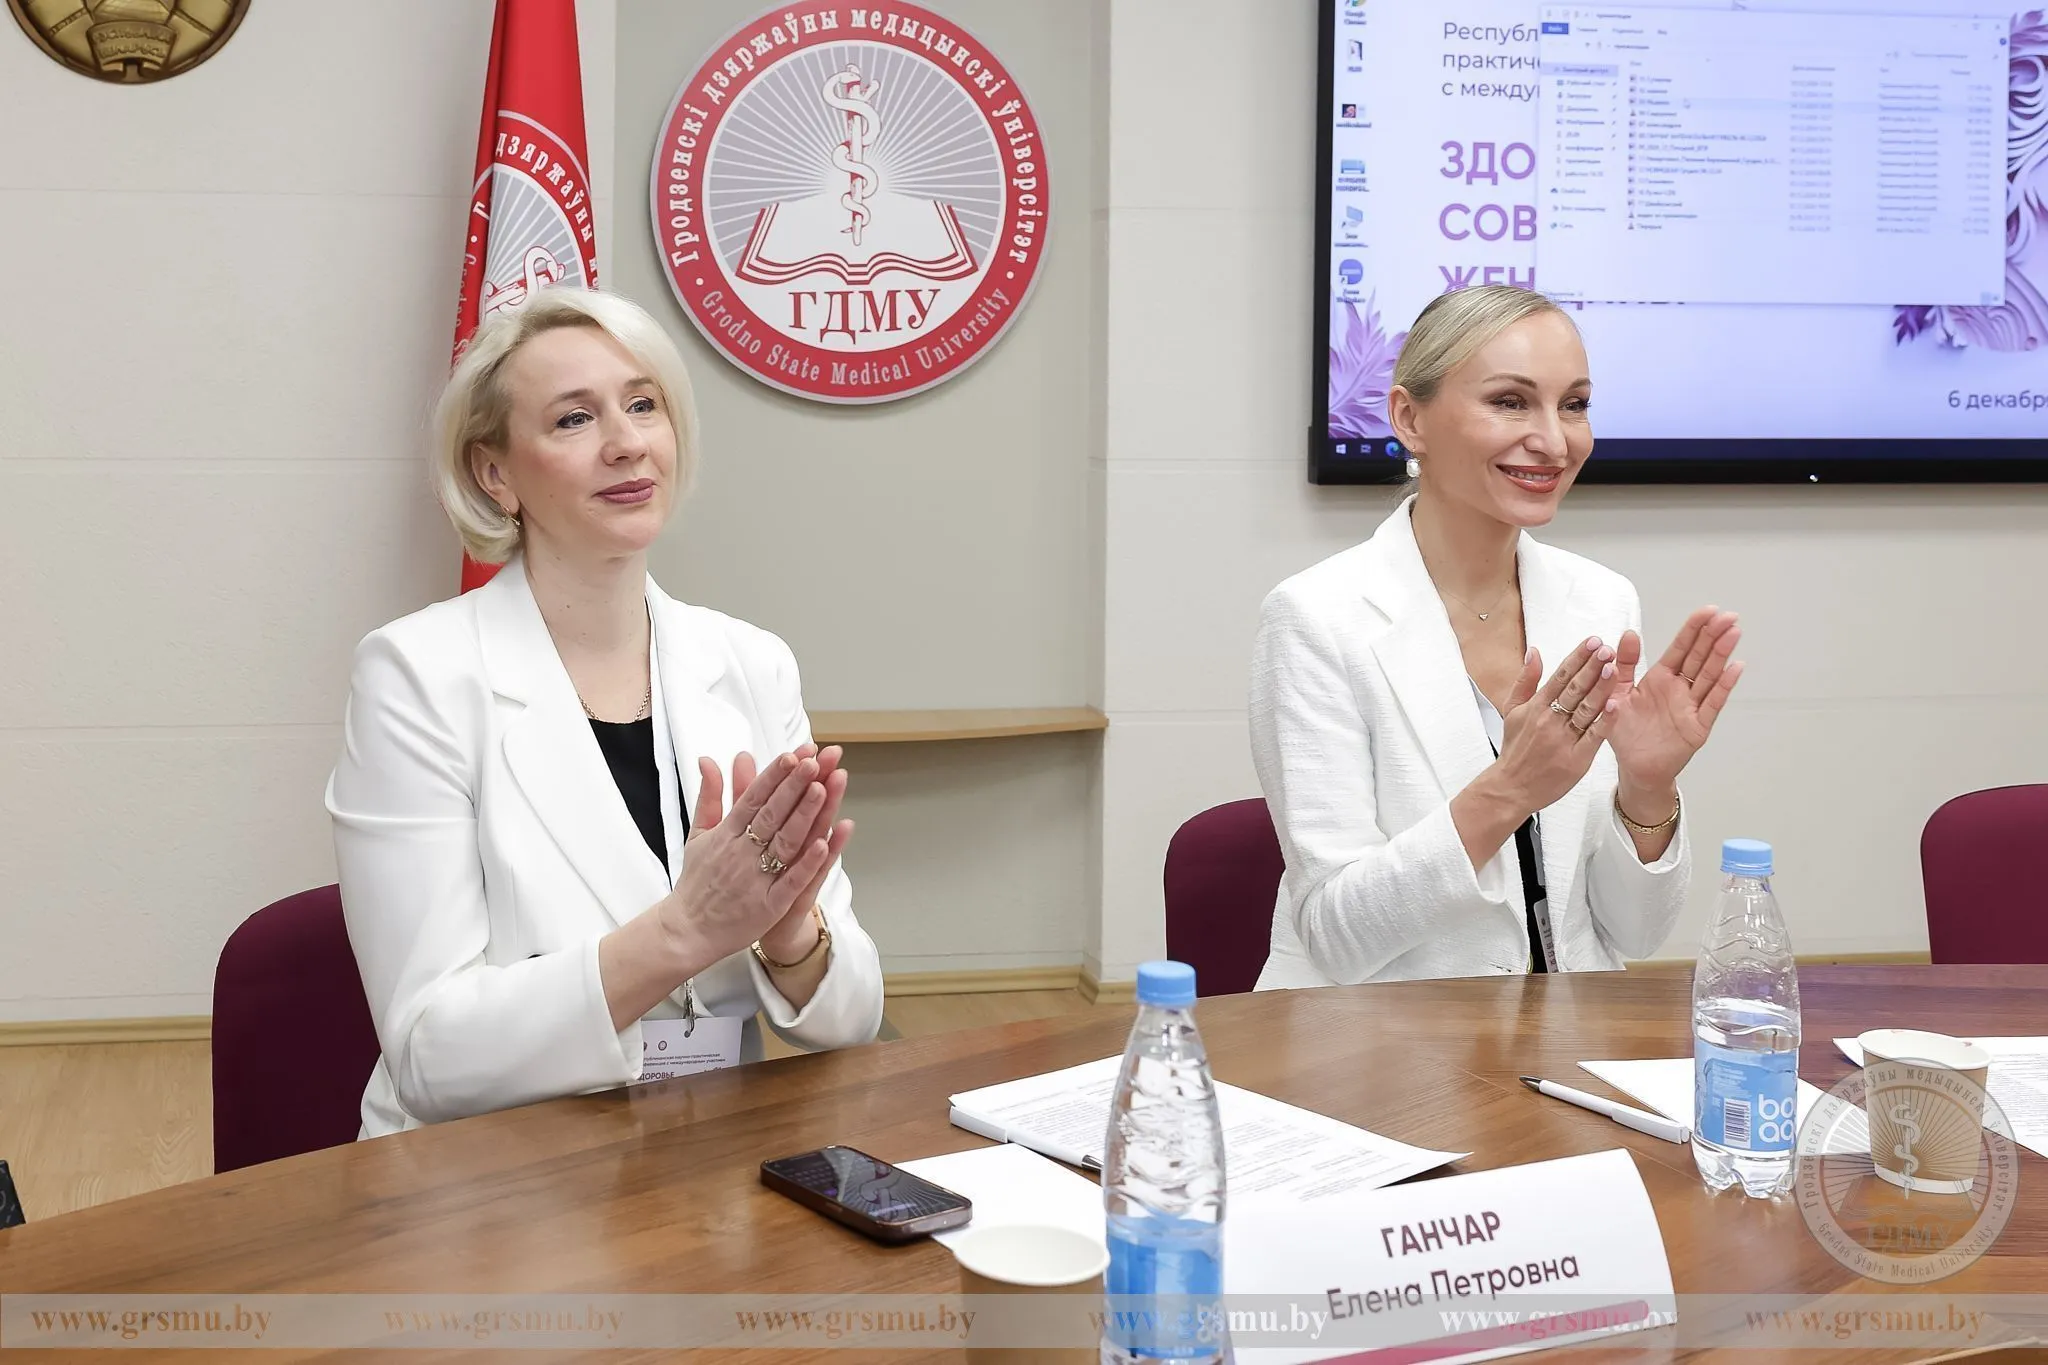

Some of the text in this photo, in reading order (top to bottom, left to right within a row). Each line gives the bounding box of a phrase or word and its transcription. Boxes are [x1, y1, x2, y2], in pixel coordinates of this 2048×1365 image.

[1442, 83, 1453, 96] с
[669, 8, 1043, 268] Гродзенскі дзяржаўны медыцынскі ўніверсітэт
[1440, 140, 1536, 186] ЗДО
[495, 132, 592, 243] дзяржаўны
[1439, 203, 1537, 241] СОВ
[702, 287, 1011, 386] Grodno State Medical University
[788, 288, 941, 345] ГДМУ
[1948, 390, 2048, 411] 6 декабр
[1380, 1211, 1501, 1258] ГАНЧАР
[1326, 1255, 1580, 1320] Елена Петровна
